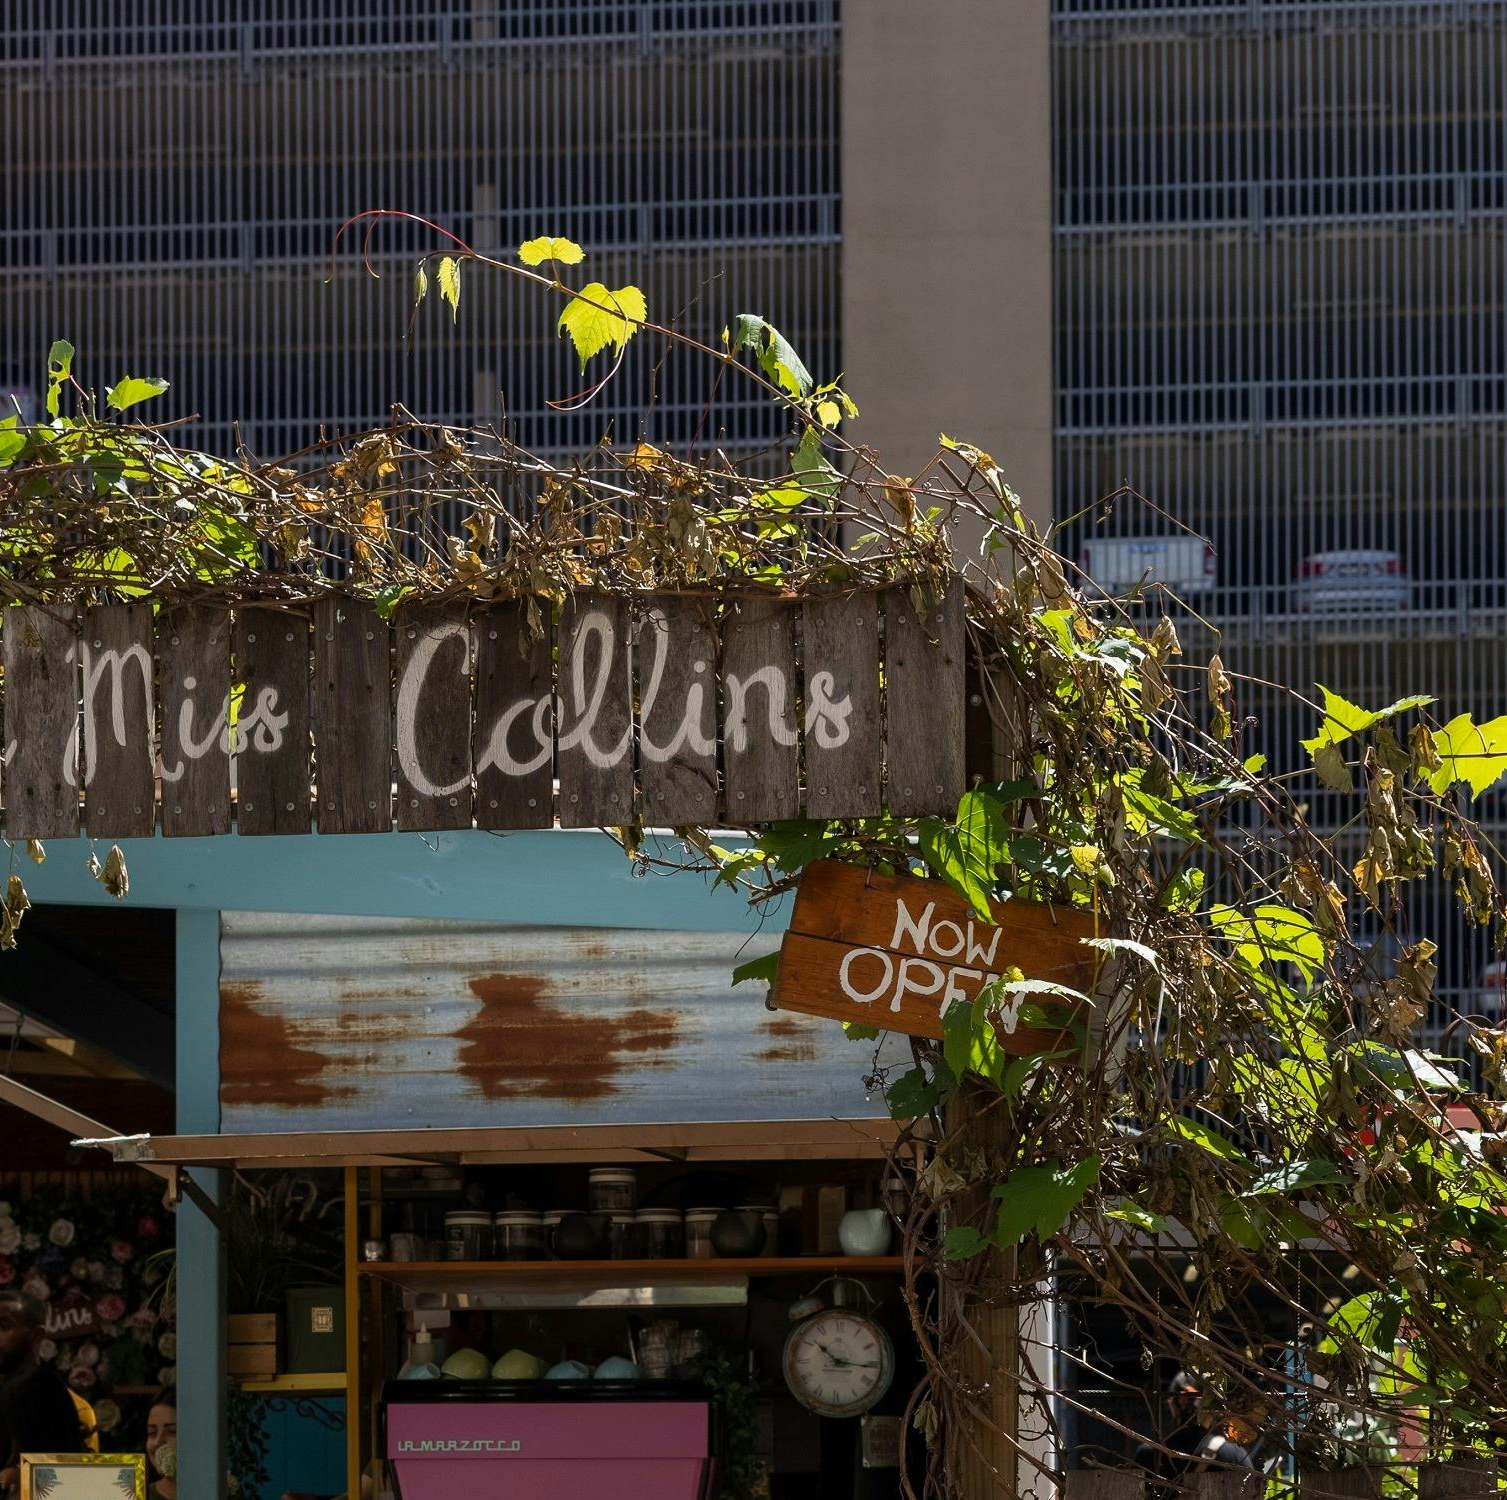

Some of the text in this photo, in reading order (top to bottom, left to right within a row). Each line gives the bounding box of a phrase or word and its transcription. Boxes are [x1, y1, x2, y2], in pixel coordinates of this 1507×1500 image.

[63, 641, 289, 787] Miss
[397, 608, 854, 796] Collins
[890, 898, 1002, 966] NOW
